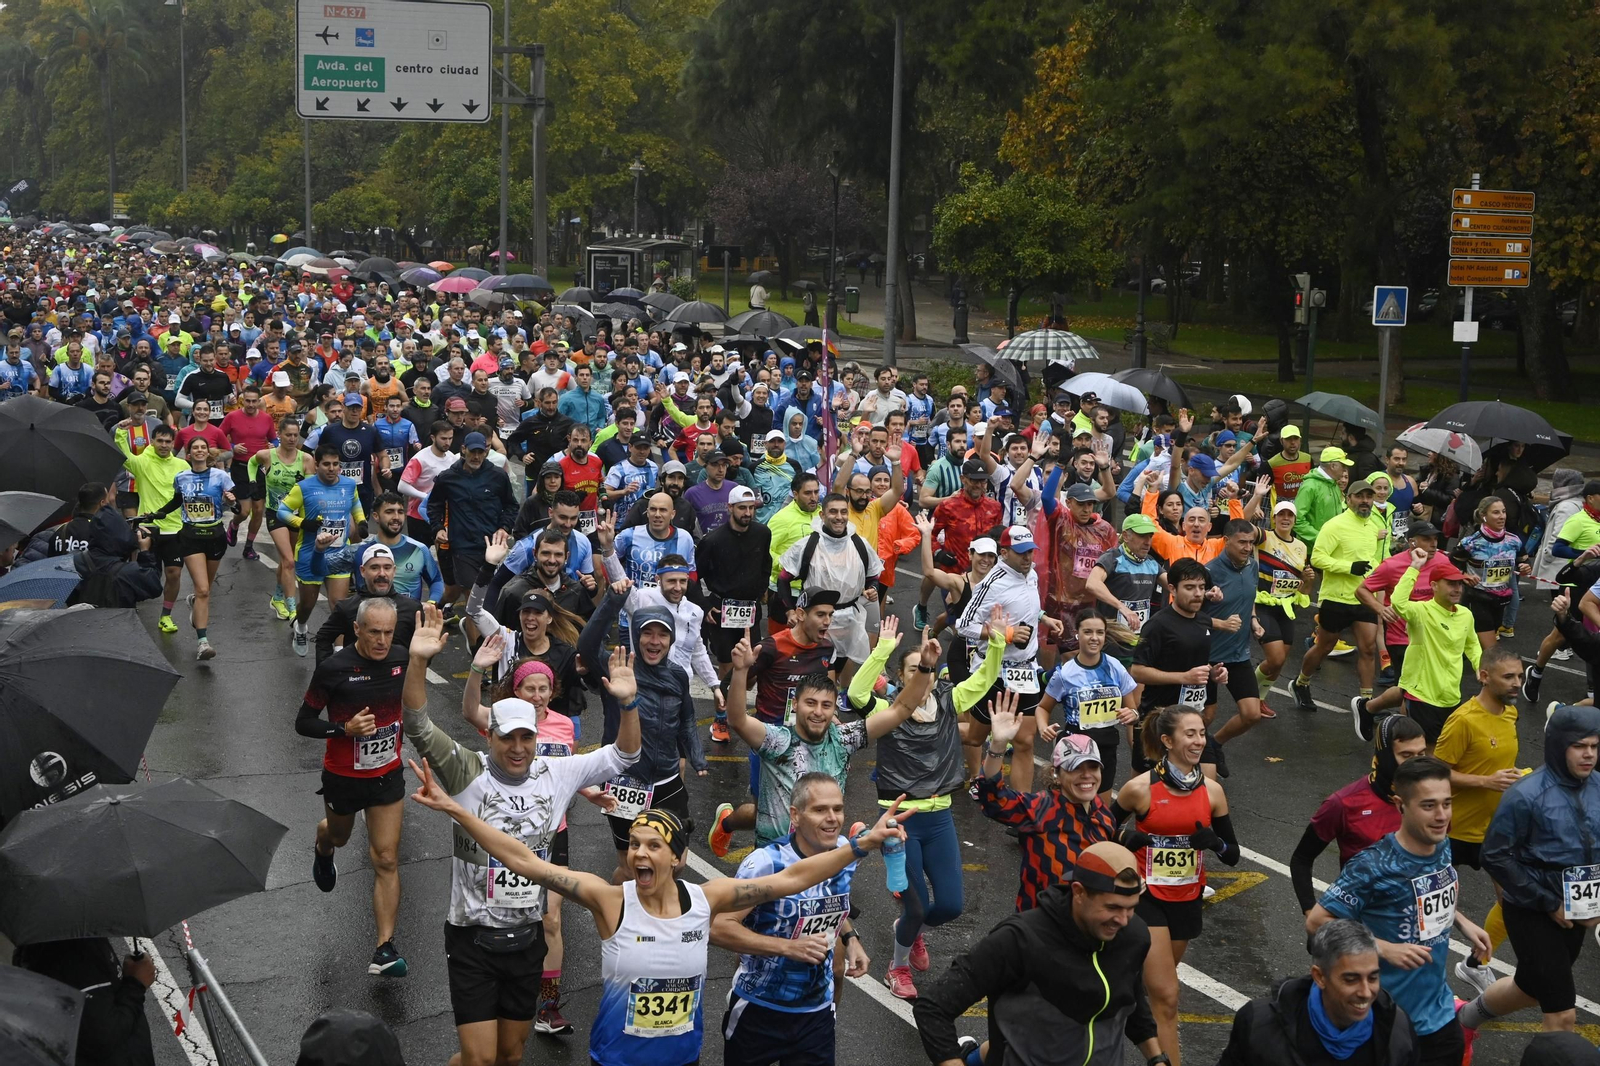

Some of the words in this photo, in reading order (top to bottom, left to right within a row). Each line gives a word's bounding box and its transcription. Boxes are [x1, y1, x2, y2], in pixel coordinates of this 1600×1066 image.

[326, 7, 364, 18] N-437
[316, 60, 349, 71] Avda.
[354, 61, 373, 72] del
[395, 64, 433, 73] centro
[440, 65, 479, 75] ciudad
[311, 76, 378, 89] Aeropuerto
[341, 469, 361, 477] 4880
[188, 504, 210, 513] 5660
[1487, 568, 1511, 577] 3169
[1276, 580, 1300, 589] 5242
[726, 607, 751, 617] 4765
[1007, 670, 1033, 682] 3244
[1085, 700, 1117, 715] 7712
[361, 736, 396, 756] 1223
[610, 786, 646, 806] 3888
[454, 834, 478, 854] 1984
[1153, 851, 1195, 867] 4631
[1423, 886, 1455, 916] 6760
[802, 914, 842, 936] 4254
[636, 994, 690, 1017] 3341
